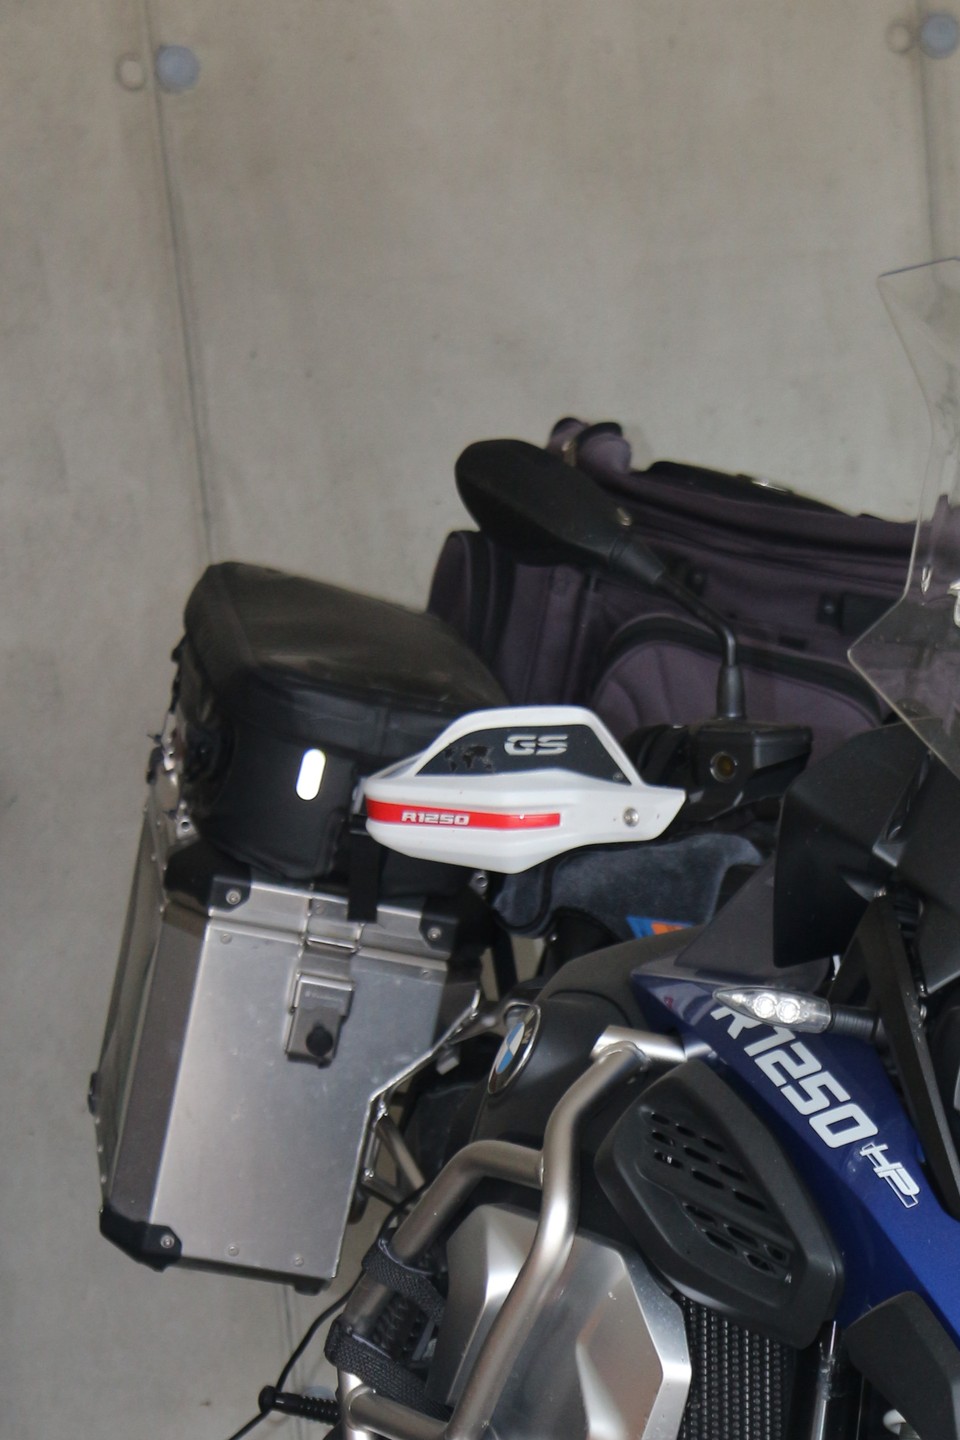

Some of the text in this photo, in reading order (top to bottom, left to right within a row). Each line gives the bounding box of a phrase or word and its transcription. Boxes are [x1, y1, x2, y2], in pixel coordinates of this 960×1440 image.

[504, 735, 568, 755] GS
[402, 812, 469, 825] R1250
[860, 1143, 919, 1208] HP
